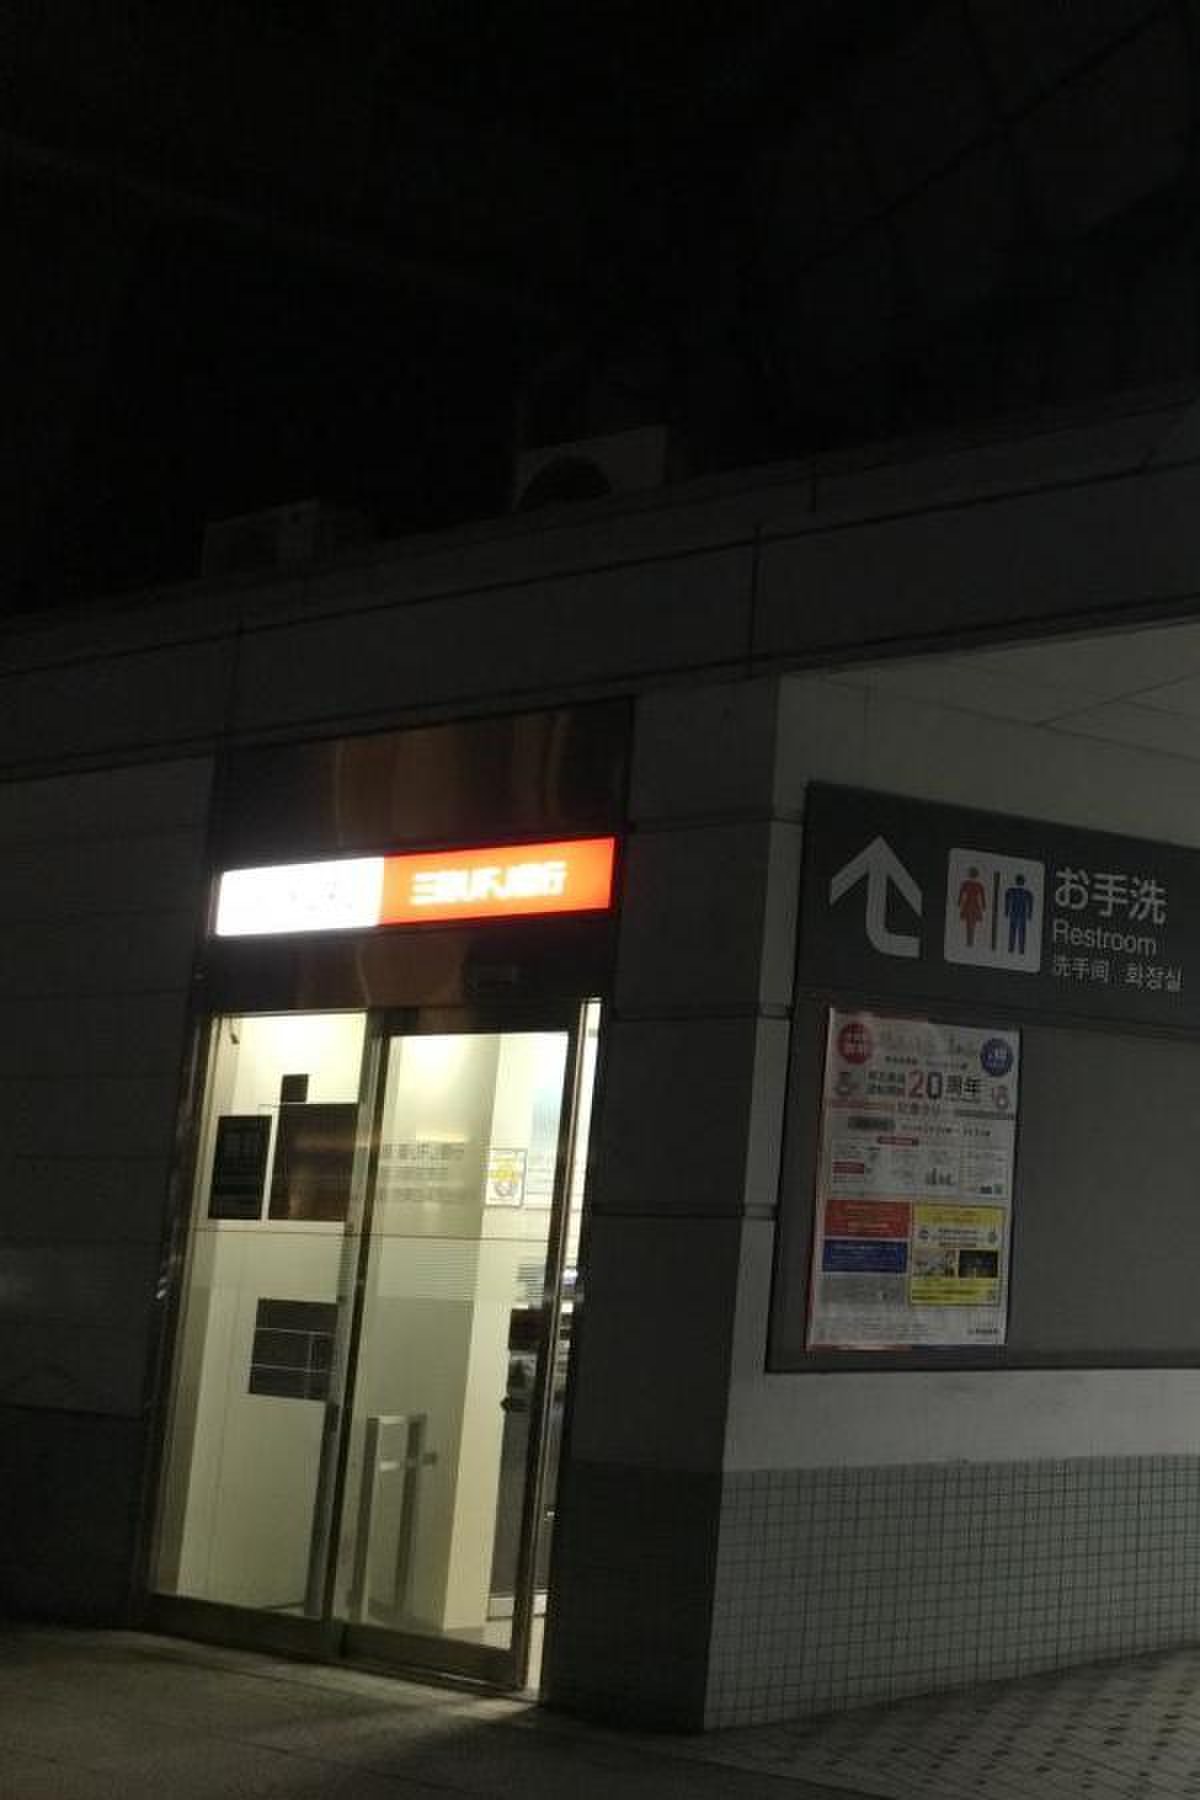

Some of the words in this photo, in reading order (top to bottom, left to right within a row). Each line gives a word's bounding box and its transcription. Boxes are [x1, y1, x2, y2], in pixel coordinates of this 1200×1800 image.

[1054, 866, 1167, 926] お手洗
[1053, 917, 1158, 958] Restroom
